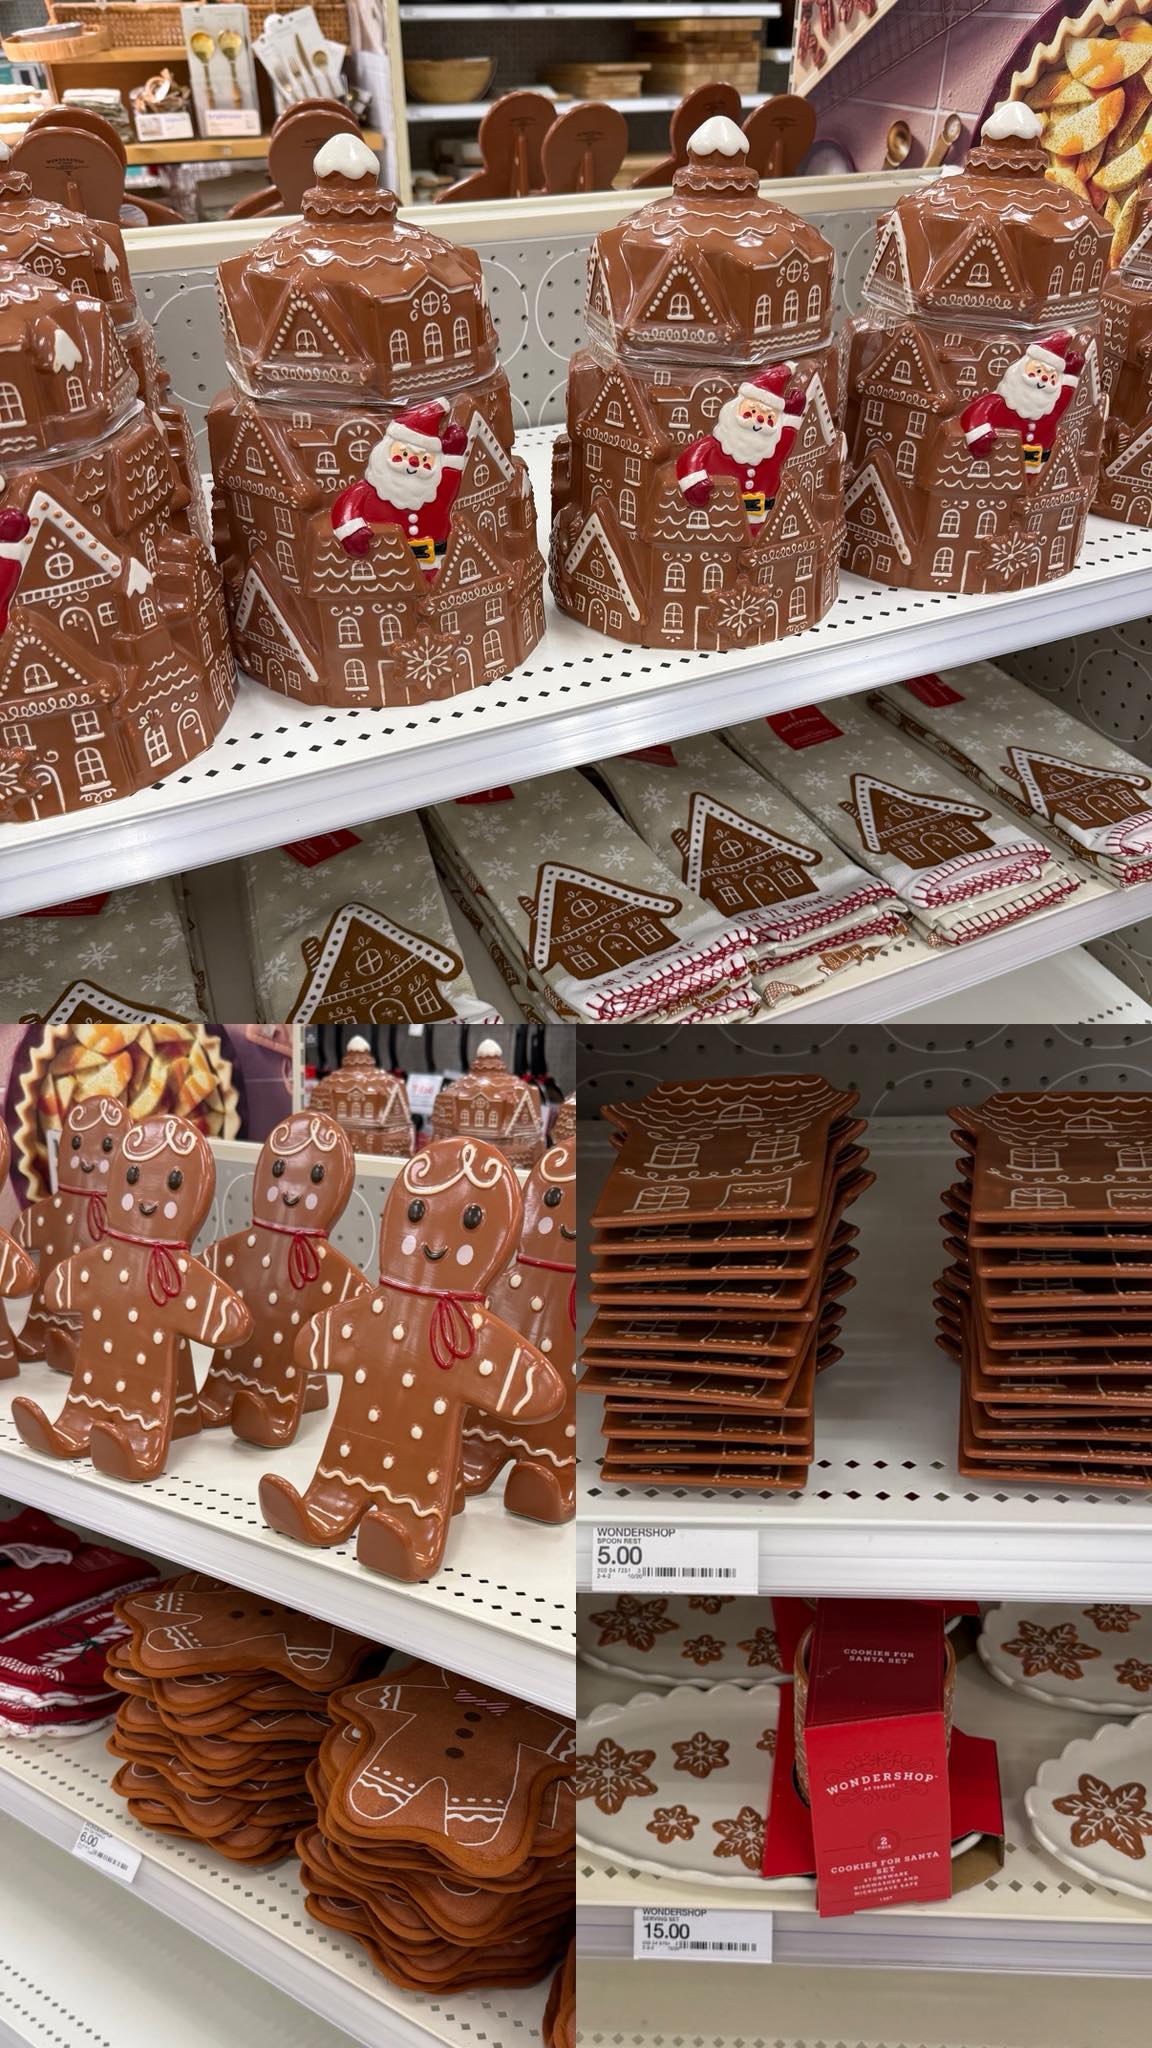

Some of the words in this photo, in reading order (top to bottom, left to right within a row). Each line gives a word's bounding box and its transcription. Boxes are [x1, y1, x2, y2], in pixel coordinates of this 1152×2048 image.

[597, 1528, 676, 1537] WONDERSHOP
[598, 1546, 642, 1565] 5.00
[843, 1648, 890, 1657] COOKIES
[849, 1655, 885, 1663] SANTA
[826, 1772, 936, 1796] WONDERSHOP
[81, 1831, 98, 1847] 6.00
[881, 1836, 887, 1845] 2
[831, 1861, 878, 1874] COOKIES
[881, 1857, 901, 1866] FOR
[904, 1851, 939, 1862] SANTA
[876, 1866, 896, 1874] SET
[643, 1908, 707, 1917] WONDERSHOP
[644, 1923, 690, 1939] 15.00
